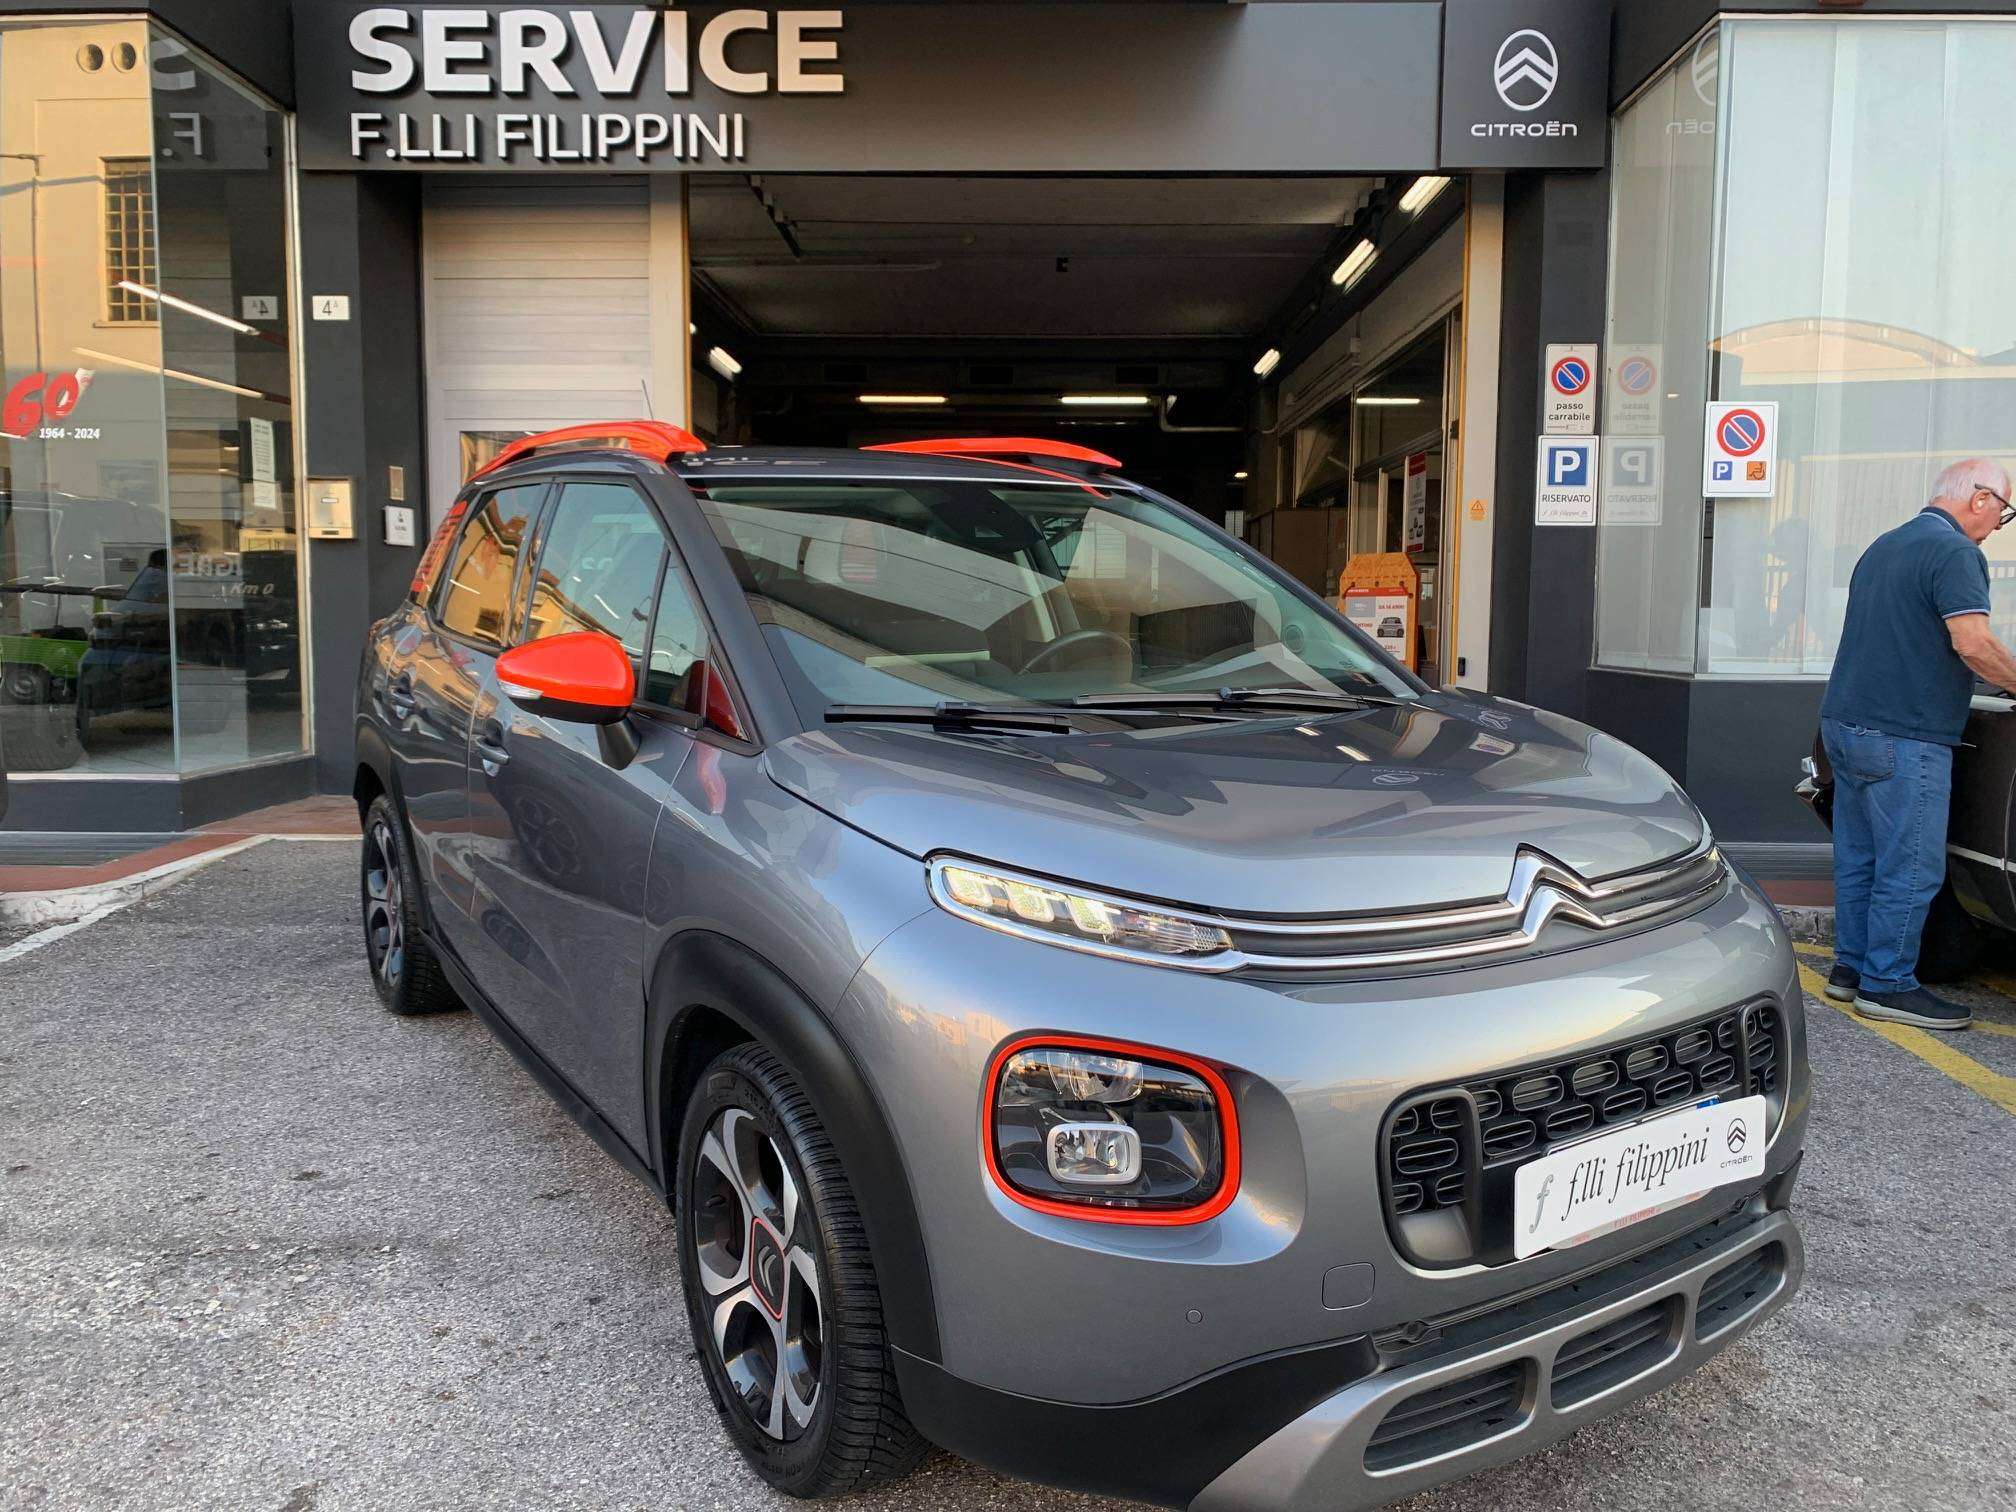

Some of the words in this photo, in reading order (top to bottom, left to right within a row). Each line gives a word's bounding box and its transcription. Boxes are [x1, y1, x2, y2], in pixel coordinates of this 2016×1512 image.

[348, 9, 844, 94] SERVICE
[350, 112, 475, 160] F.LLI
[498, 112, 744, 160] FILIPPINI
[1556, 402, 1584, 411] passo
[1548, 412, 1591, 421] carrabile
[39, 427, 65, 439] 1964
[74, 427, 101, 439] 2024
[1554, 450, 1581, 483] P
[1716, 462, 1729, 479] P
[1542, 494, 1591, 503] RISERVATO
[1561, 1157, 1607, 1222] f.lli
[1608, 1127, 1710, 1204] filippini
